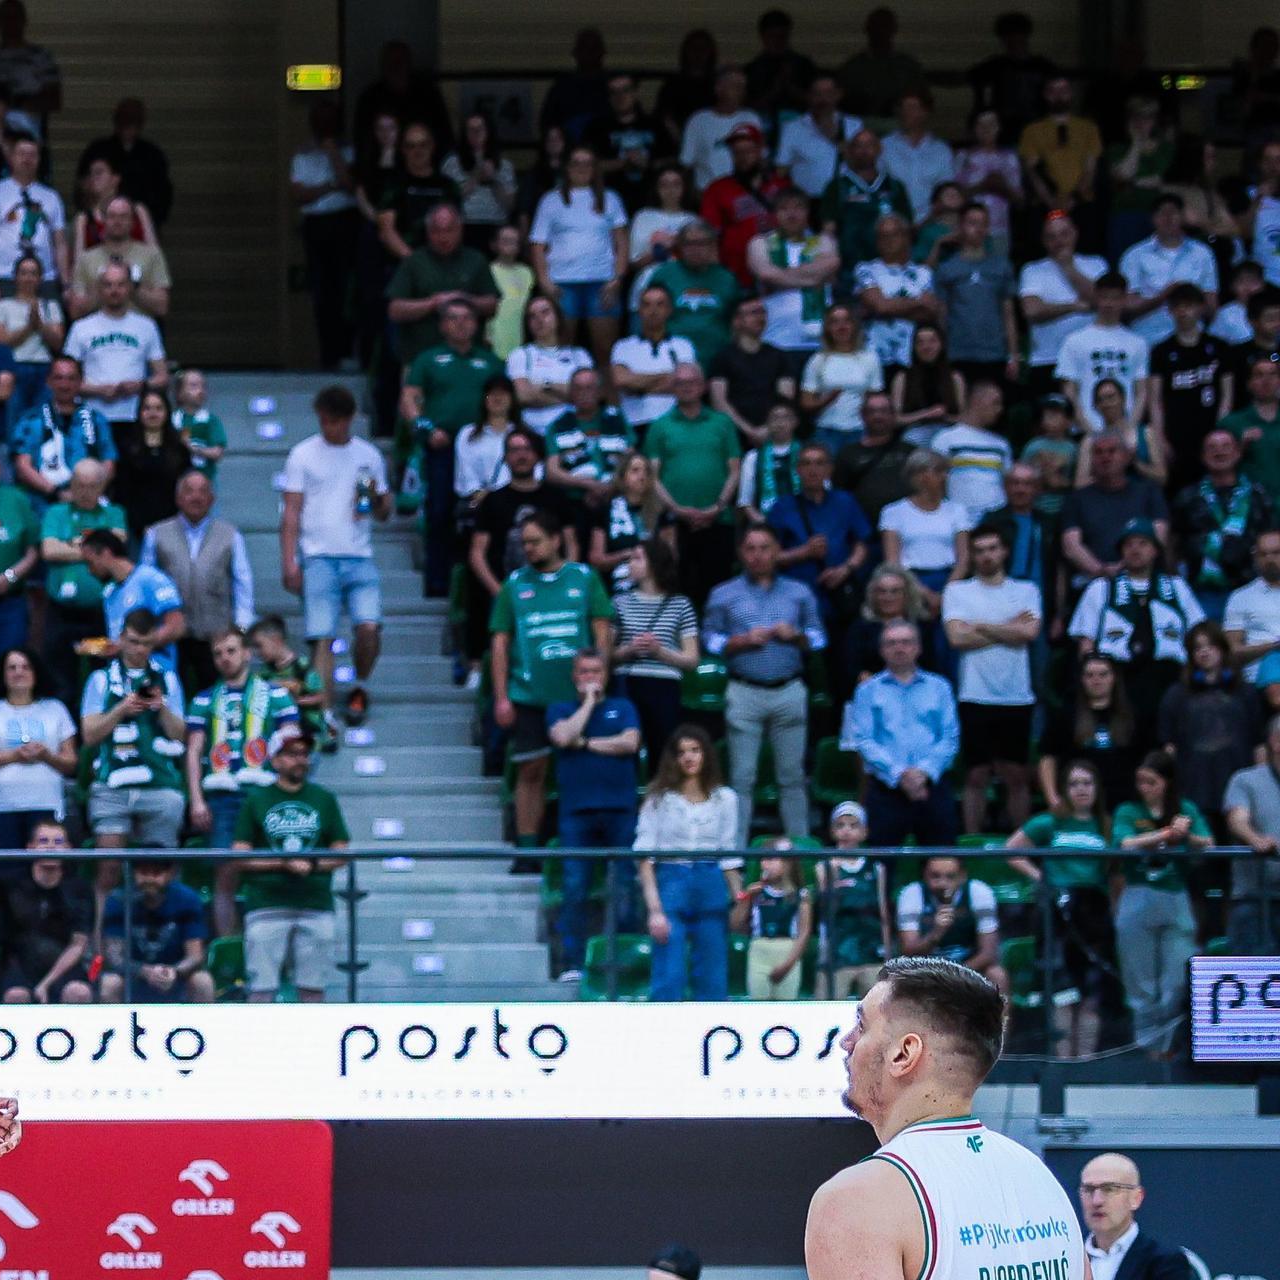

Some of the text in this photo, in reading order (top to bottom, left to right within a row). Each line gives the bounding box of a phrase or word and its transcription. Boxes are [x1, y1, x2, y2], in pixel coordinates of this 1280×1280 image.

[339, 1008, 568, 1076] posto
[172, 1198, 235, 1217] ORLEN
[99, 1252, 163, 1270] ORLEN
[243, 1251, 306, 1269] ORLEN
